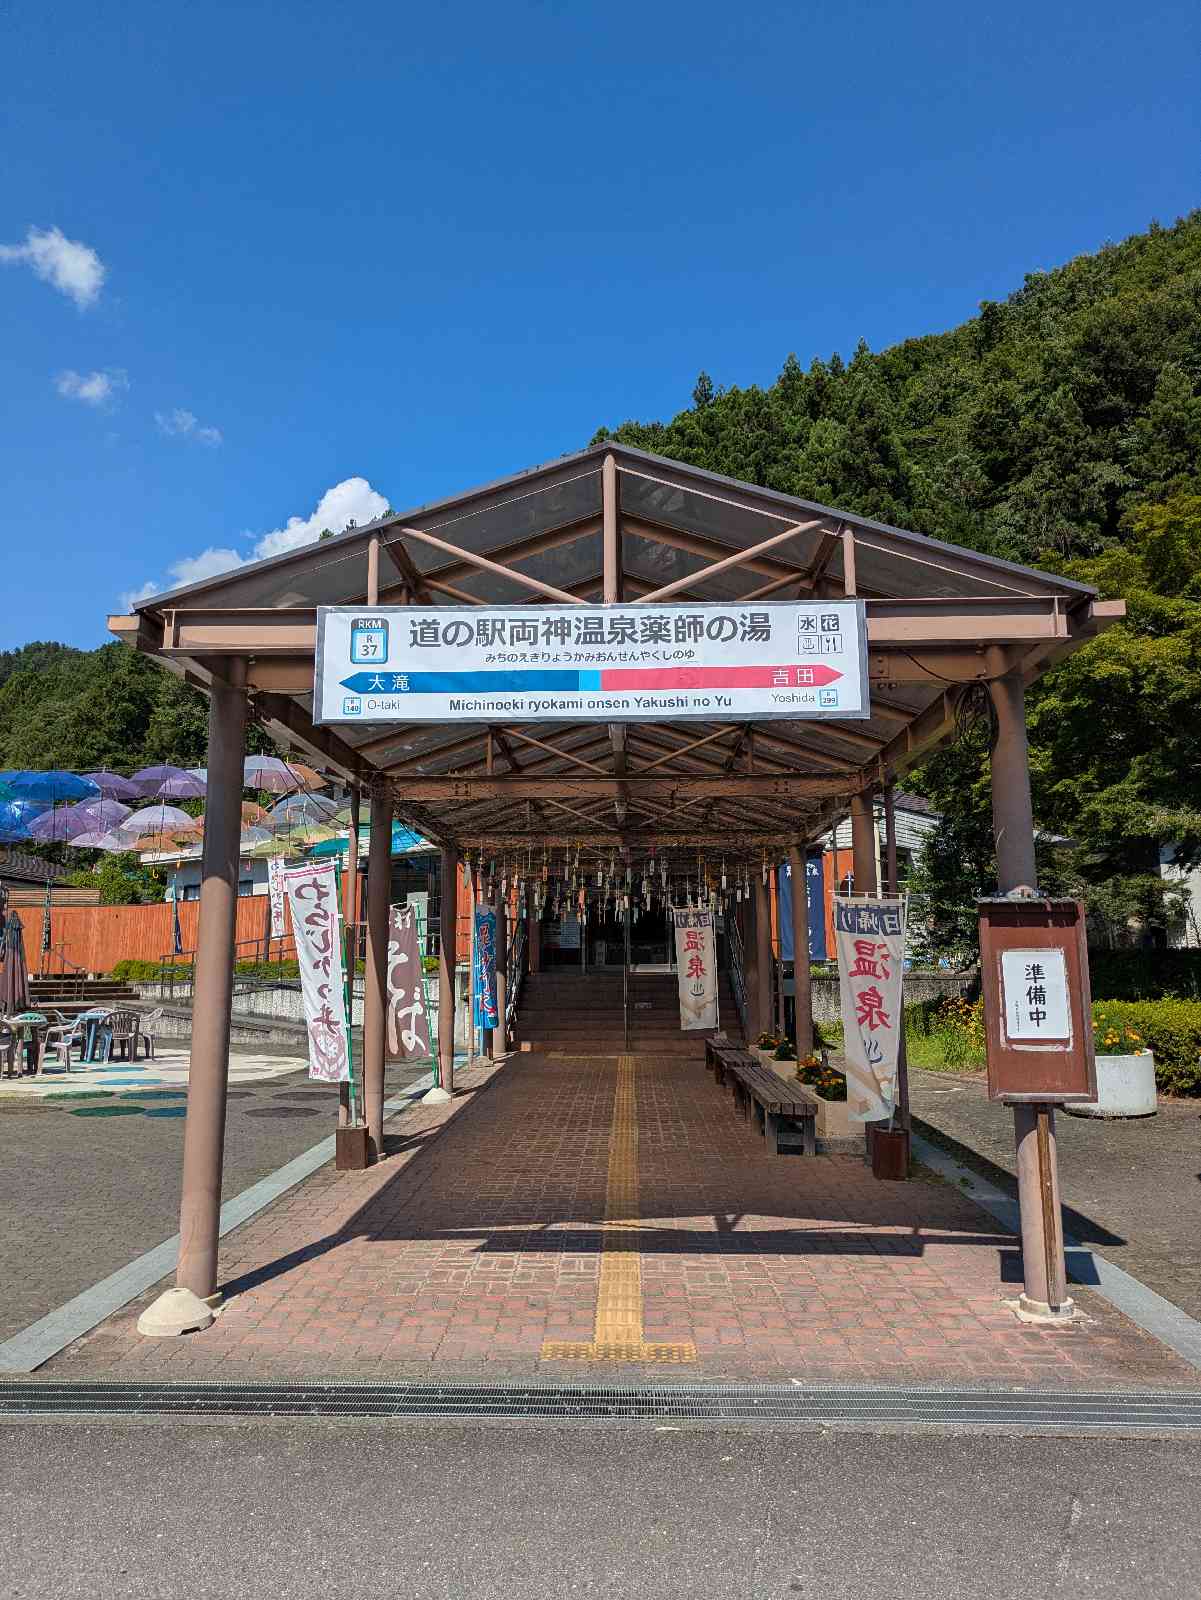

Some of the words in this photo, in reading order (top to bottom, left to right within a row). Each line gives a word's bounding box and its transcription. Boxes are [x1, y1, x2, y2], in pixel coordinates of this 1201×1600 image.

[358, 619, 382, 629] RKM
[409, 612, 771, 648] 道の駅両神温泉薬師の湯
[800, 616, 816, 631] 水
[822, 615, 839, 632] 花
[366, 635, 373, 643] R
[360, 644, 378, 656] 37
[485, 650, 695, 663] みちのえきりょうかみおんせんやくしのゆ
[367, 699, 401, 710] O-taki
[449, 698, 524, 711] Michinoeki
[527, 698, 583, 712] ryokami
[587, 698, 629, 709] onsen
[634, 696, 688, 708] Yakushi
[693, 697, 710, 707] no
[714, 695, 732, 707] Yu
[771, 693, 816, 704] Yoshida
[1024, 963, 1048, 1028] 準備中
